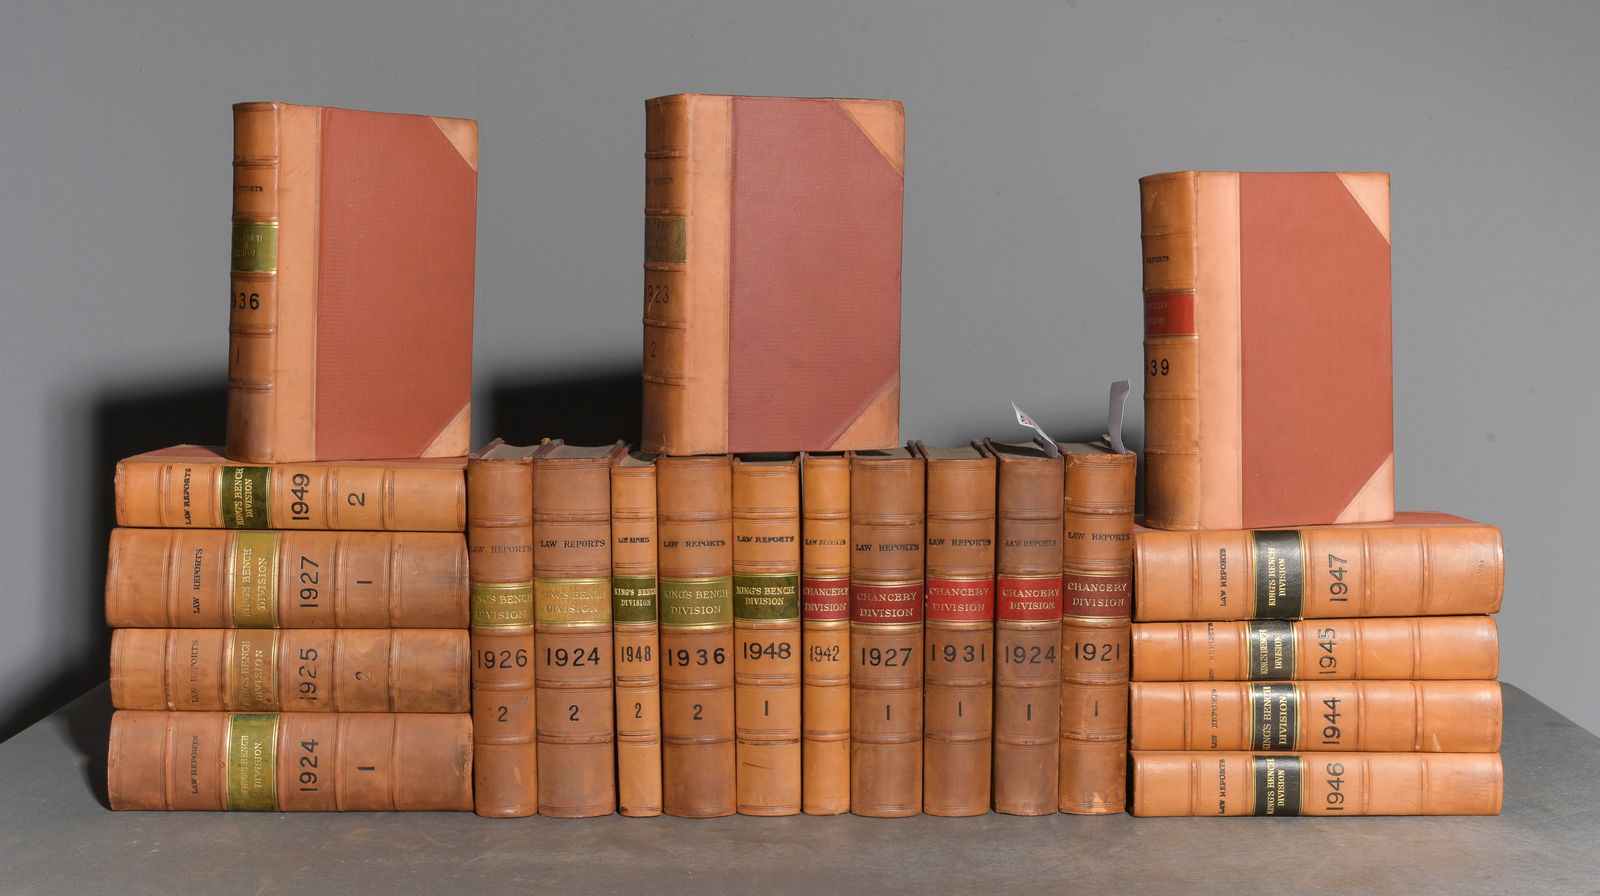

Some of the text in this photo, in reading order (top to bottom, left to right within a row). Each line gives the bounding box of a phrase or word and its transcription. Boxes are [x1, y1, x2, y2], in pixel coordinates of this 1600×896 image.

[235, 468, 244, 498] BENCH
[184, 468, 192, 525] LAW REPORTS
[245, 478, 254, 518] DIVISION
[292, 474, 309, 520] 1949
[348, 493, 365, 506] 2
[541, 540, 606, 548] LAW REPORTS
[686, 540, 726, 548] REPORTS
[755, 535, 795, 544] REPORTS
[928, 538, 992, 546] LAW REPORTS
[1023, 540, 1057, 548] REPORTS
[1092, 533, 1130, 541] REPORTS
[491, 545, 533, 553] REPORTS
[878, 543, 920, 551] REPORTS
[242, 548, 253, 583] BENCH
[1219, 548, 1227, 587] REPORTS
[192, 548, 203, 614] LAW REPORTS
[257, 557, 267, 611] DIVISION
[301, 556, 319, 607] 1927
[1266, 548, 1276, 607] KING'S BENCH
[1278, 558, 1286, 596] DIVISION
[1329, 553, 1347, 603] 1947
[695, 589, 729, 599] BENCH
[763, 586, 795, 595] BENCH
[803, 587, 849, 596] CHANCERY
[929, 587, 989, 597] CHANCERY
[1002, 589, 1060, 598] CHANCERY
[1067, 582, 1127, 592] CHANCERY
[500, 594, 533, 604] BENCH
[621, 599, 651, 607] DIVISION
[744, 597, 785, 605] DIVISION
[856, 592, 917, 602] CHANCERY
[1010, 601, 1056, 610] DIVISION
[1072, 598, 1125, 607] DIVISION
[671, 606, 721, 615] DIVISION
[804, 602, 847, 611] DIVISION
[860, 608, 913, 618] DIVISION
[932, 603, 985, 612] DIVISION
[240, 640, 251, 675] BENCH
[478, 649, 527, 669] 1926
[546, 647, 600, 667] 1924
[621, 646, 651, 662] 1948
[667, 648, 726, 666] 1936
[743, 642, 791, 659] 1948
[809, 646, 840, 662] 1942
[862, 648, 913, 666] 1927
[932, 644, 985, 662] 1931
[1004, 646, 1057, 664] 1924
[1075, 642, 1120, 661] 1921
[1274, 636, 1282, 669] DIVISION
[1319, 628, 1337, 675] 1945
[254, 649, 264, 701] DIVISION
[299, 648, 318, 701] 1925
[355, 670, 370, 681] 2
[568, 705, 579, 721] 2
[635, 702, 642, 719] 2
[693, 704, 703, 720] 2
[1262, 687, 1272, 721] BENCH
[498, 706, 508, 722] 2
[1278, 695, 1288, 745] DIVISION
[1322, 697, 1341, 745] 1944
[240, 735, 249, 764] BENCH
[191, 735, 199, 795] LAW REPORTS
[300, 739, 319, 792] 1924
[1218, 759, 1226, 798] REPORTS
[1266, 758, 1275, 815] KING'S BENCH
[1326, 762, 1345, 812] 1946
[1277, 770, 1285, 807] DIVISION
